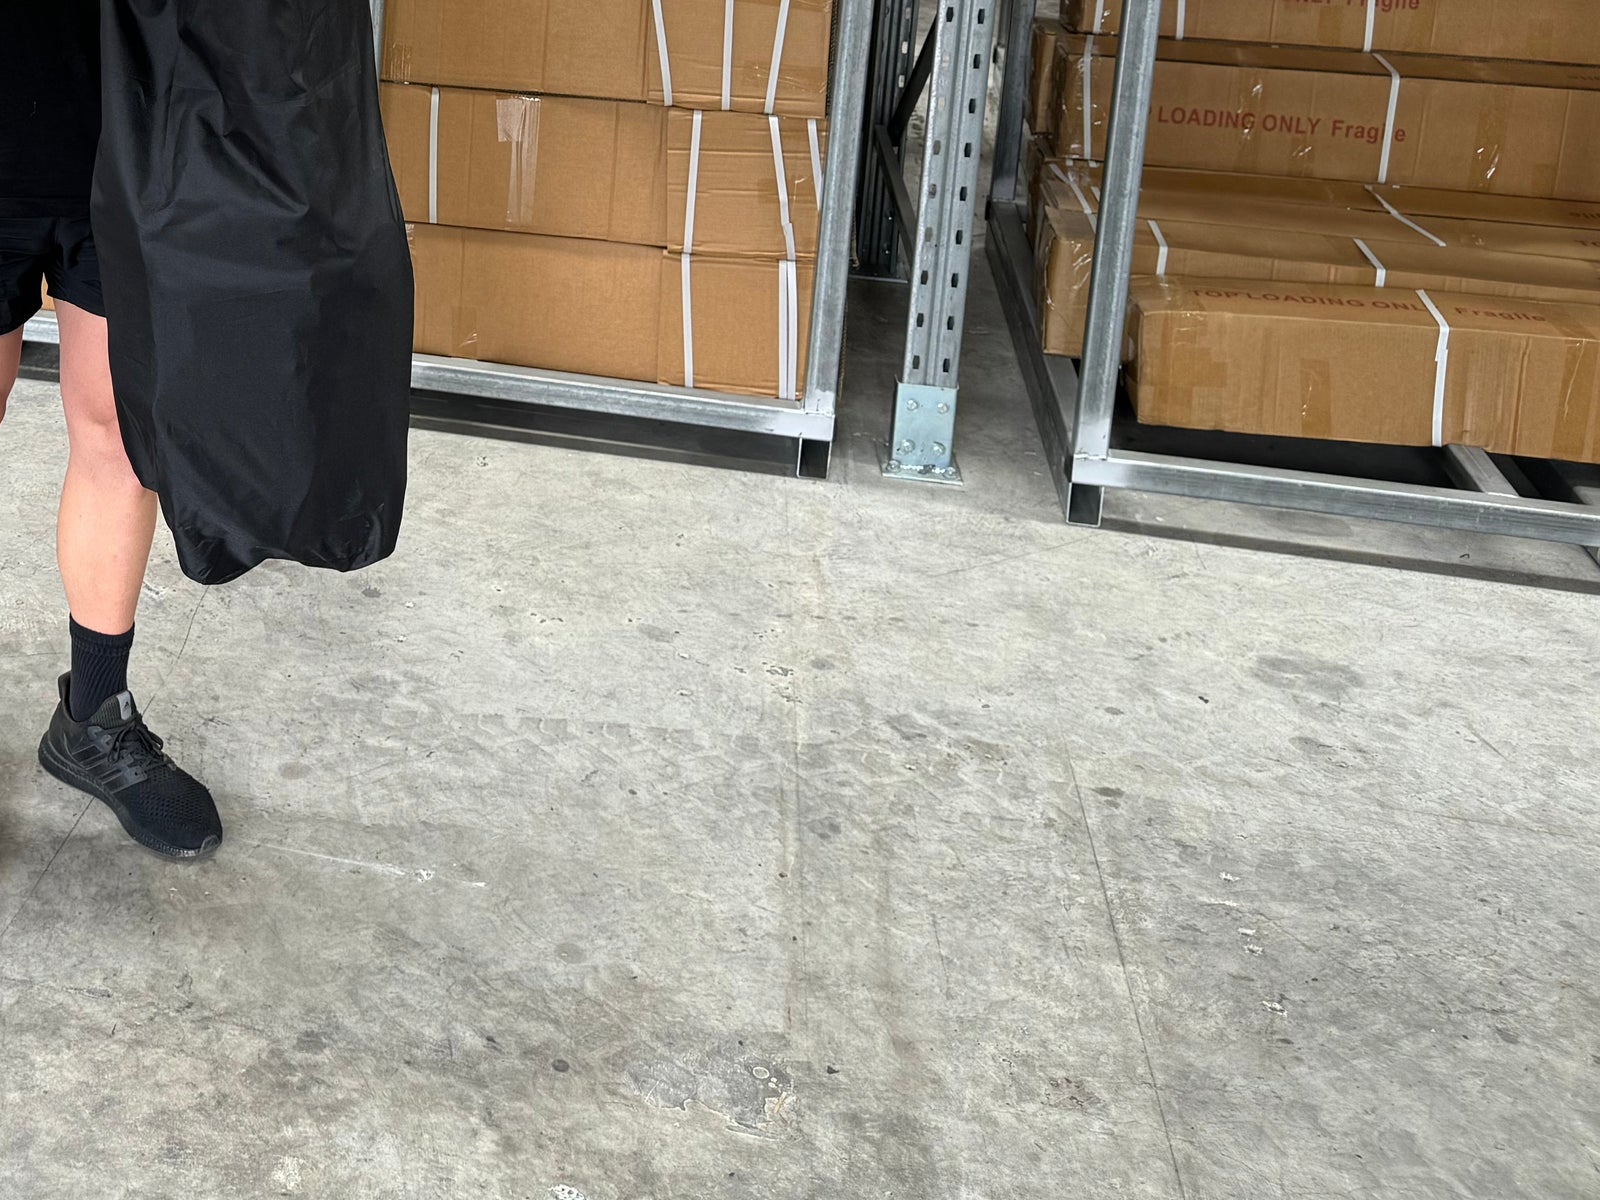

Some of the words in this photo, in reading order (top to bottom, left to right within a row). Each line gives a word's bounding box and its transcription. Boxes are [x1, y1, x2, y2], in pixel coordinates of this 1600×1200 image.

[1157, 106, 1255, 129] LOADING
[1261, 114, 1321, 135] ONLY
[1193, 289, 1240, 300] TOP
[1247, 292, 1365, 308] LOADING
[1372, 300, 1428, 312] ONL
[1455, 306, 1546, 322] Fragile
